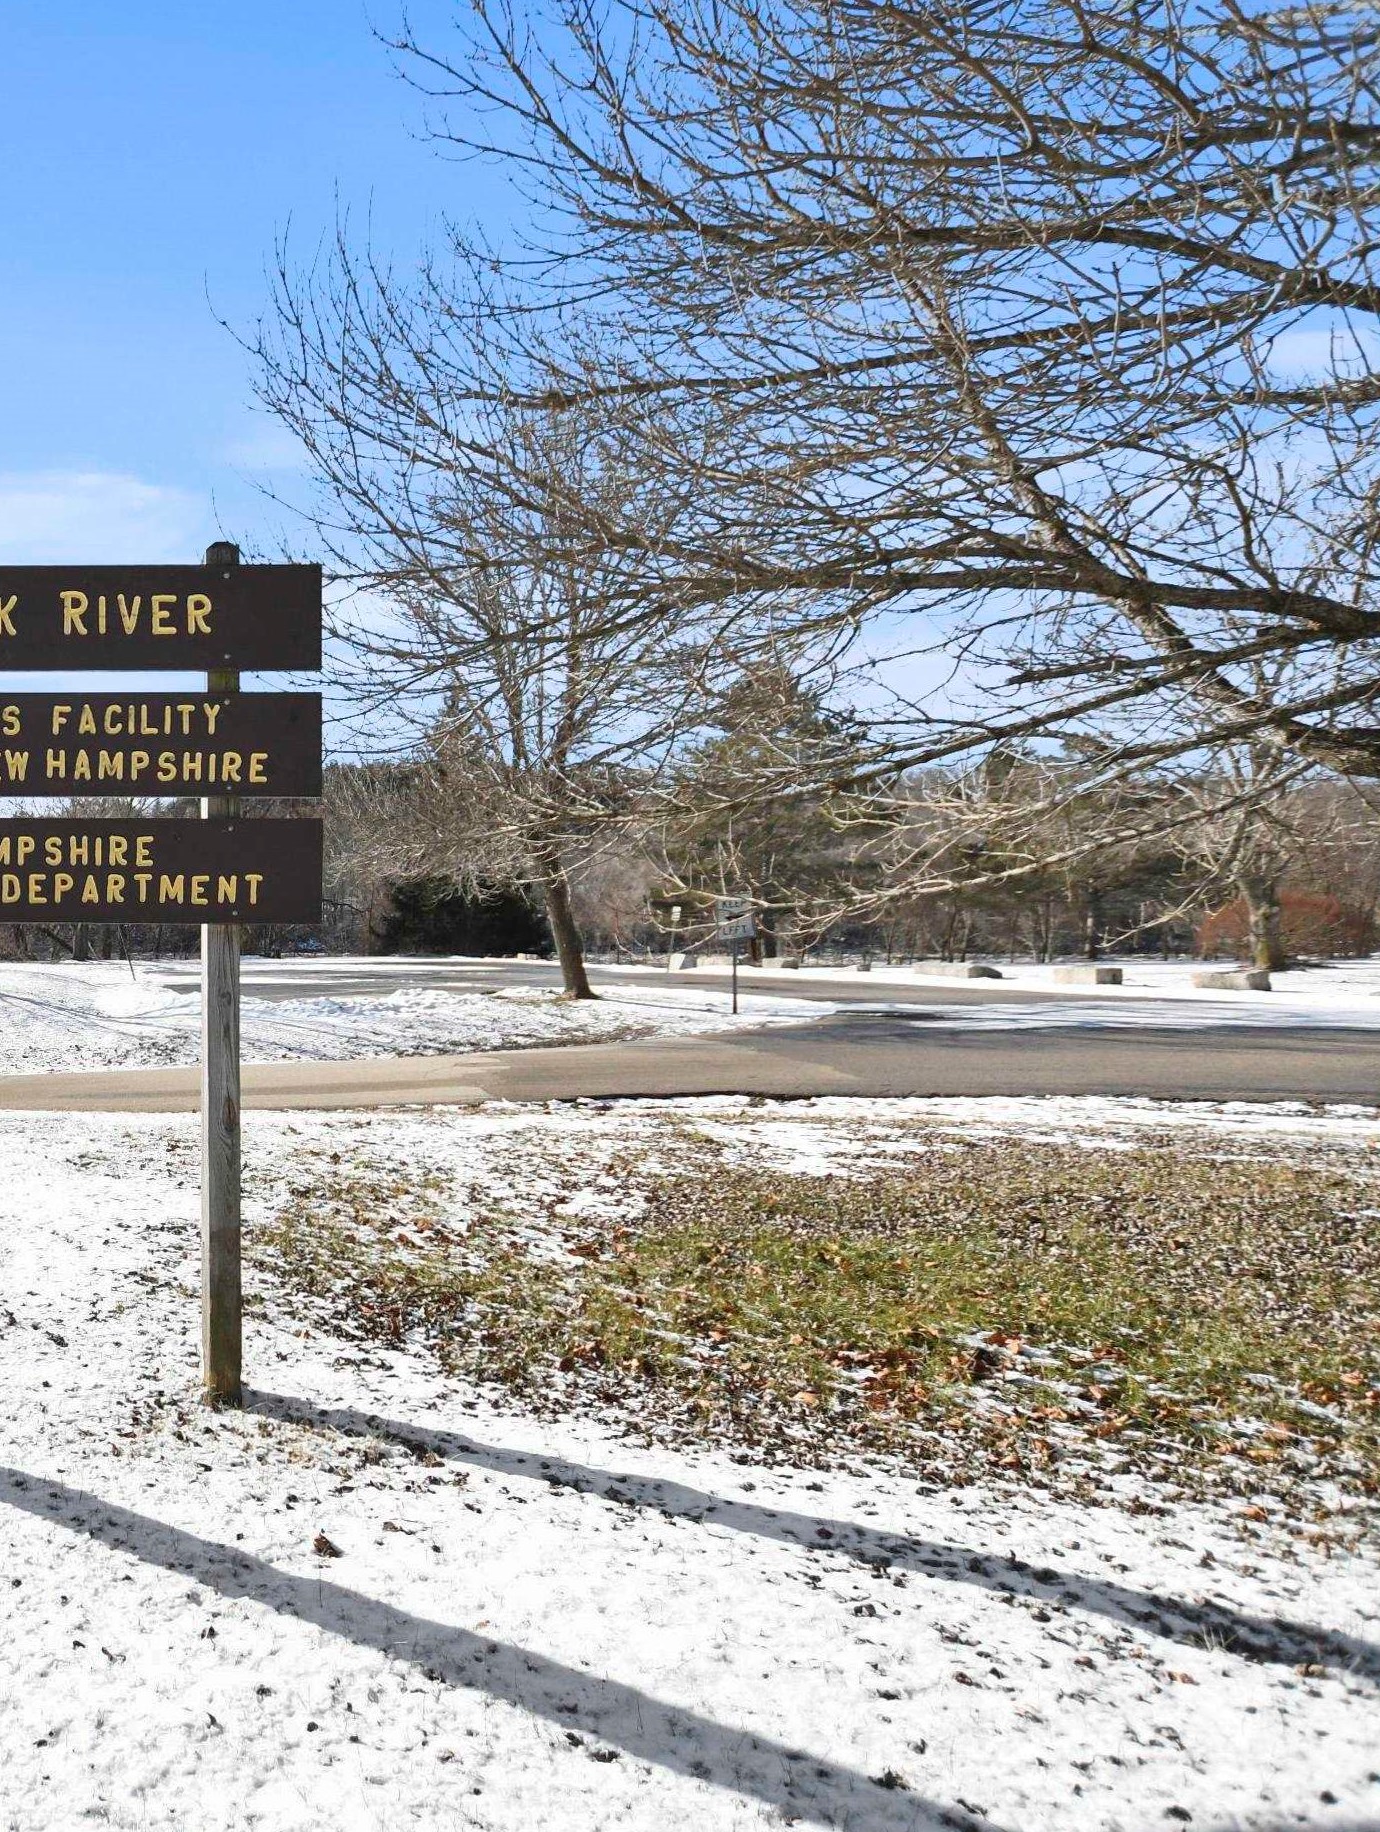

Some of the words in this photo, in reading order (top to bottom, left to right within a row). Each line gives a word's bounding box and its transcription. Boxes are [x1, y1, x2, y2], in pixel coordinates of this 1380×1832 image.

[59, 590, 213, 635] RIVER
[51, 703, 221, 736] FACILITY
[45, 748, 269, 783] HAMPSHIRE
[0, 873, 264, 906] DEPARTMENT
